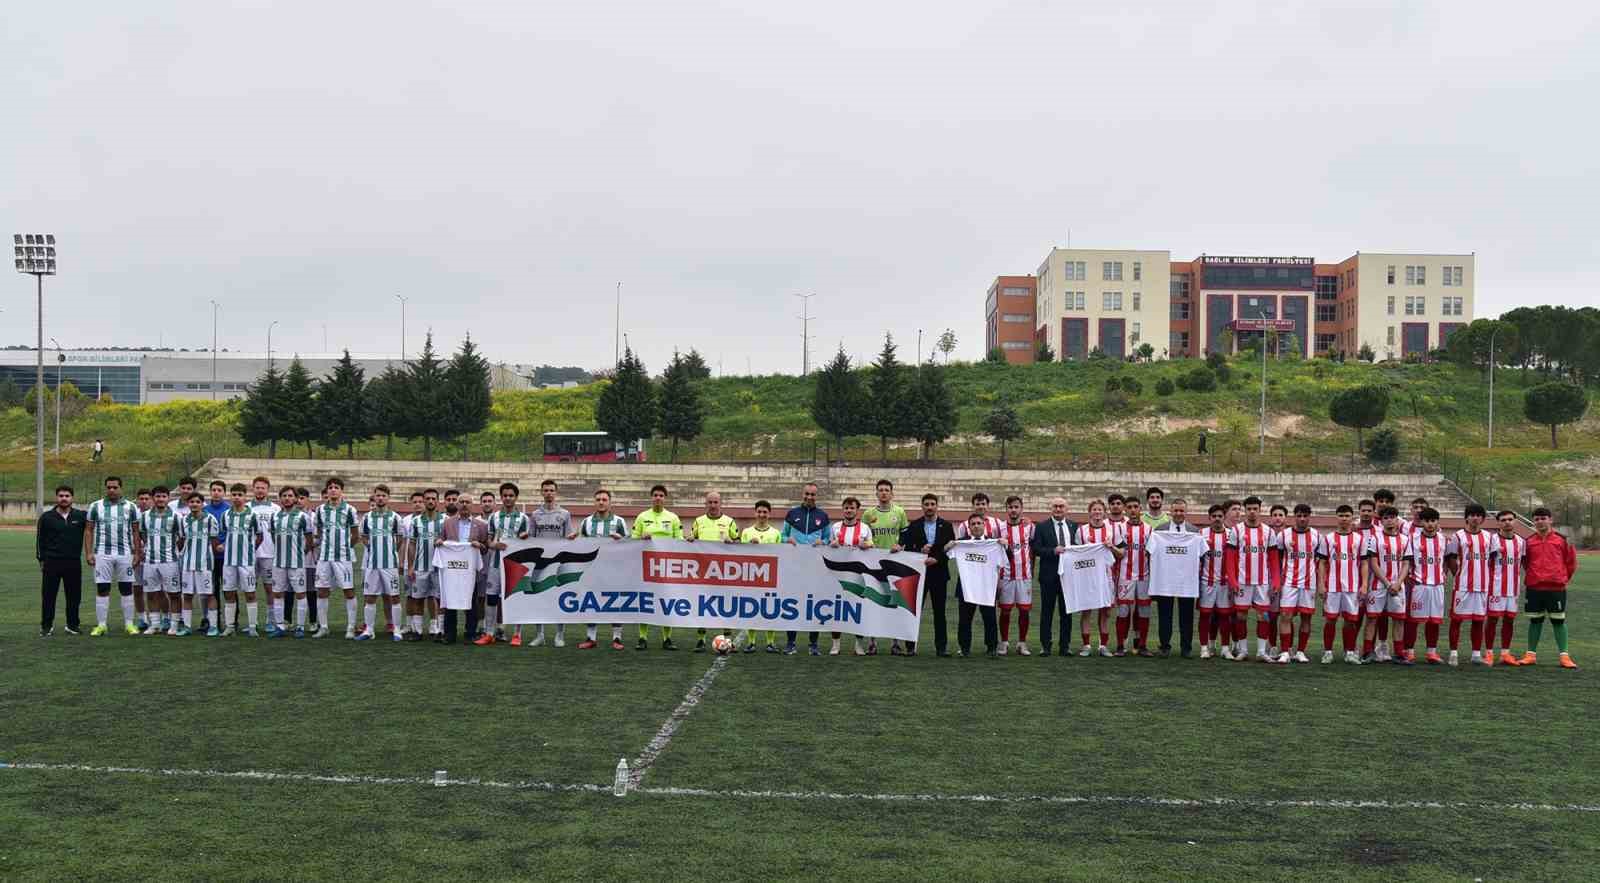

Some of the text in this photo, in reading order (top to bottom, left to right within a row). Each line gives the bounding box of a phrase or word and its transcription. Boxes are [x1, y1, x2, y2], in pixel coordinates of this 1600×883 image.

[650, 558, 770, 583] HER ADIM
[247, 576, 254, 586] 10
[344, 572, 351, 582] 11
[204, 579, 210, 589] 2
[558, 591, 862, 625] GAZZE ve KUDÜS İÇİN
